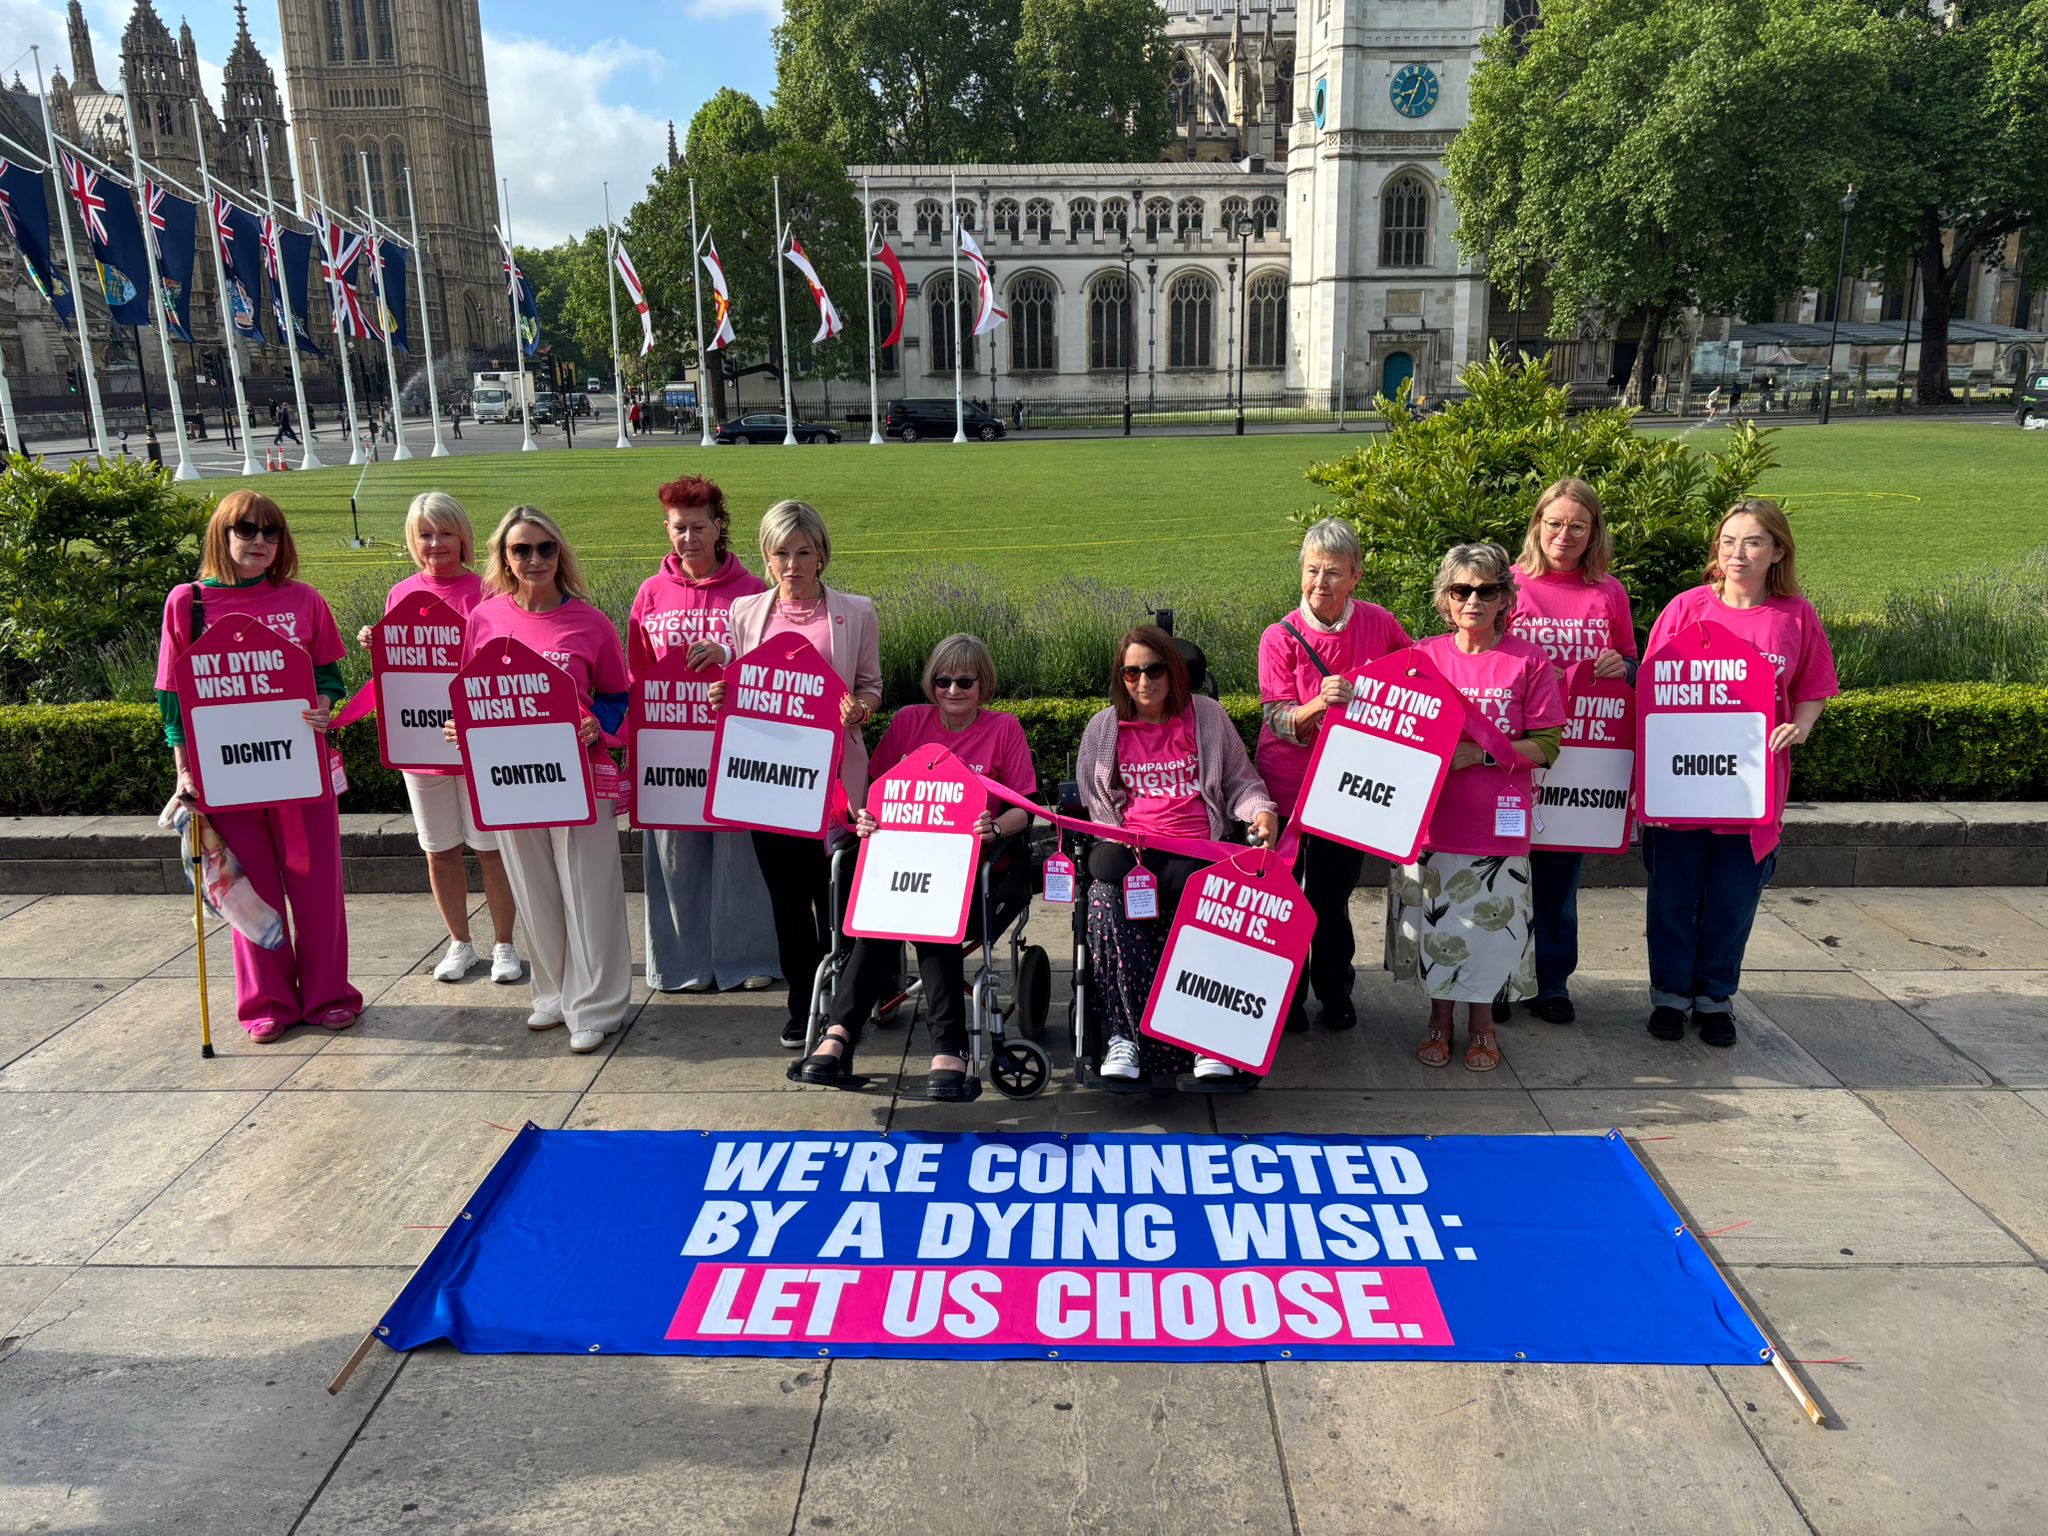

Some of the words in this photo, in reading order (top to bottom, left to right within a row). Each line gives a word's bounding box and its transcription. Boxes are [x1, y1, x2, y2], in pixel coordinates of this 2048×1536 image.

[267, 612, 295, 624] FOR
[645, 617, 732, 633] DIGNITY
[647, 609, 708, 620] CAMPAIGN
[712, 608, 729, 617] FO
[1513, 617, 1583, 627] CAMPAIGN
[1588, 618, 1610, 629] FOR
[383, 625, 408, 645] MY
[413, 625, 461, 646] DYING
[1512, 627, 1610, 646] DIGNITY
[191, 653, 221, 676] MY
[227, 649, 285, 674] DYING
[385, 646, 427, 667] WISH
[431, 646, 459, 667] IS...
[543, 650, 570, 662] FOR
[739, 663, 769, 688] MY
[772, 668, 825, 697] DYING
[1654, 660, 1684, 682] MY
[1690, 658, 1748, 682] DYING
[194, 675, 247, 699] WISH
[250, 673, 284, 695] IS...
[463, 676, 491, 698] MY
[496, 672, 551, 696] DYING
[644, 680, 671, 701] MY
[1353, 674, 1385, 702] MY
[1384, 684, 1443, 720] DYING
[1484, 687, 1513, 699] FOR
[1654, 684, 1703, 706] WISH
[1709, 683, 1742, 706] IS...
[467, 698, 516, 721] WISH
[518, 696, 550, 718] IS...
[644, 702, 688, 723] WISH
[692, 703, 717, 724] IS..
[737, 687, 783, 715] WISH
[786, 694, 815, 720] IS...
[1574, 695, 1626, 719] DYING
[1344, 699, 1395, 732] WISH
[1394, 713, 1425, 743] IS...
[1561, 718, 1585, 740] SH
[1588, 719, 1616, 742] IS...
[220, 739, 293, 766] DIGNITY
[490, 762, 567, 787] CONTROL
[644, 766, 710, 788] AUTONO
[727, 756, 820, 790] HUMANITY
[1120, 758, 1186, 773] CAMPAIGN
[1120, 764, 1197, 789] DIGNIT
[1672, 754, 1738, 776] CHOICE
[883, 779, 912, 801] MY
[914, 780, 965, 804] DYING
[1337, 771, 1397, 808] PEACE
[1536, 786, 1628, 810] OMPASSION
[881, 802, 924, 825] WISH
[927, 804, 955, 826] IS...
[890, 871, 932, 893] LOVE
[1202, 873, 1236, 903] MY
[1235, 885, 1294, 923] DYING
[1195, 897, 1246, 934] WISH
[1245, 915, 1277, 947] IS...
[1175, 969, 1267, 1020] KINDNESS
[968, 1143, 1429, 1195] CONNECTED
[680, 1200, 808, 1257] BY
[816, 1201, 884, 1258] A
[917, 1202, 1176, 1262] DYING
[1204, 1202, 1478, 1262] WISH:
[696, 1268, 861, 1336] LET
[882, 1270, 1002, 1339] US
[1036, 1270, 1424, 1341] CHOOSE.
